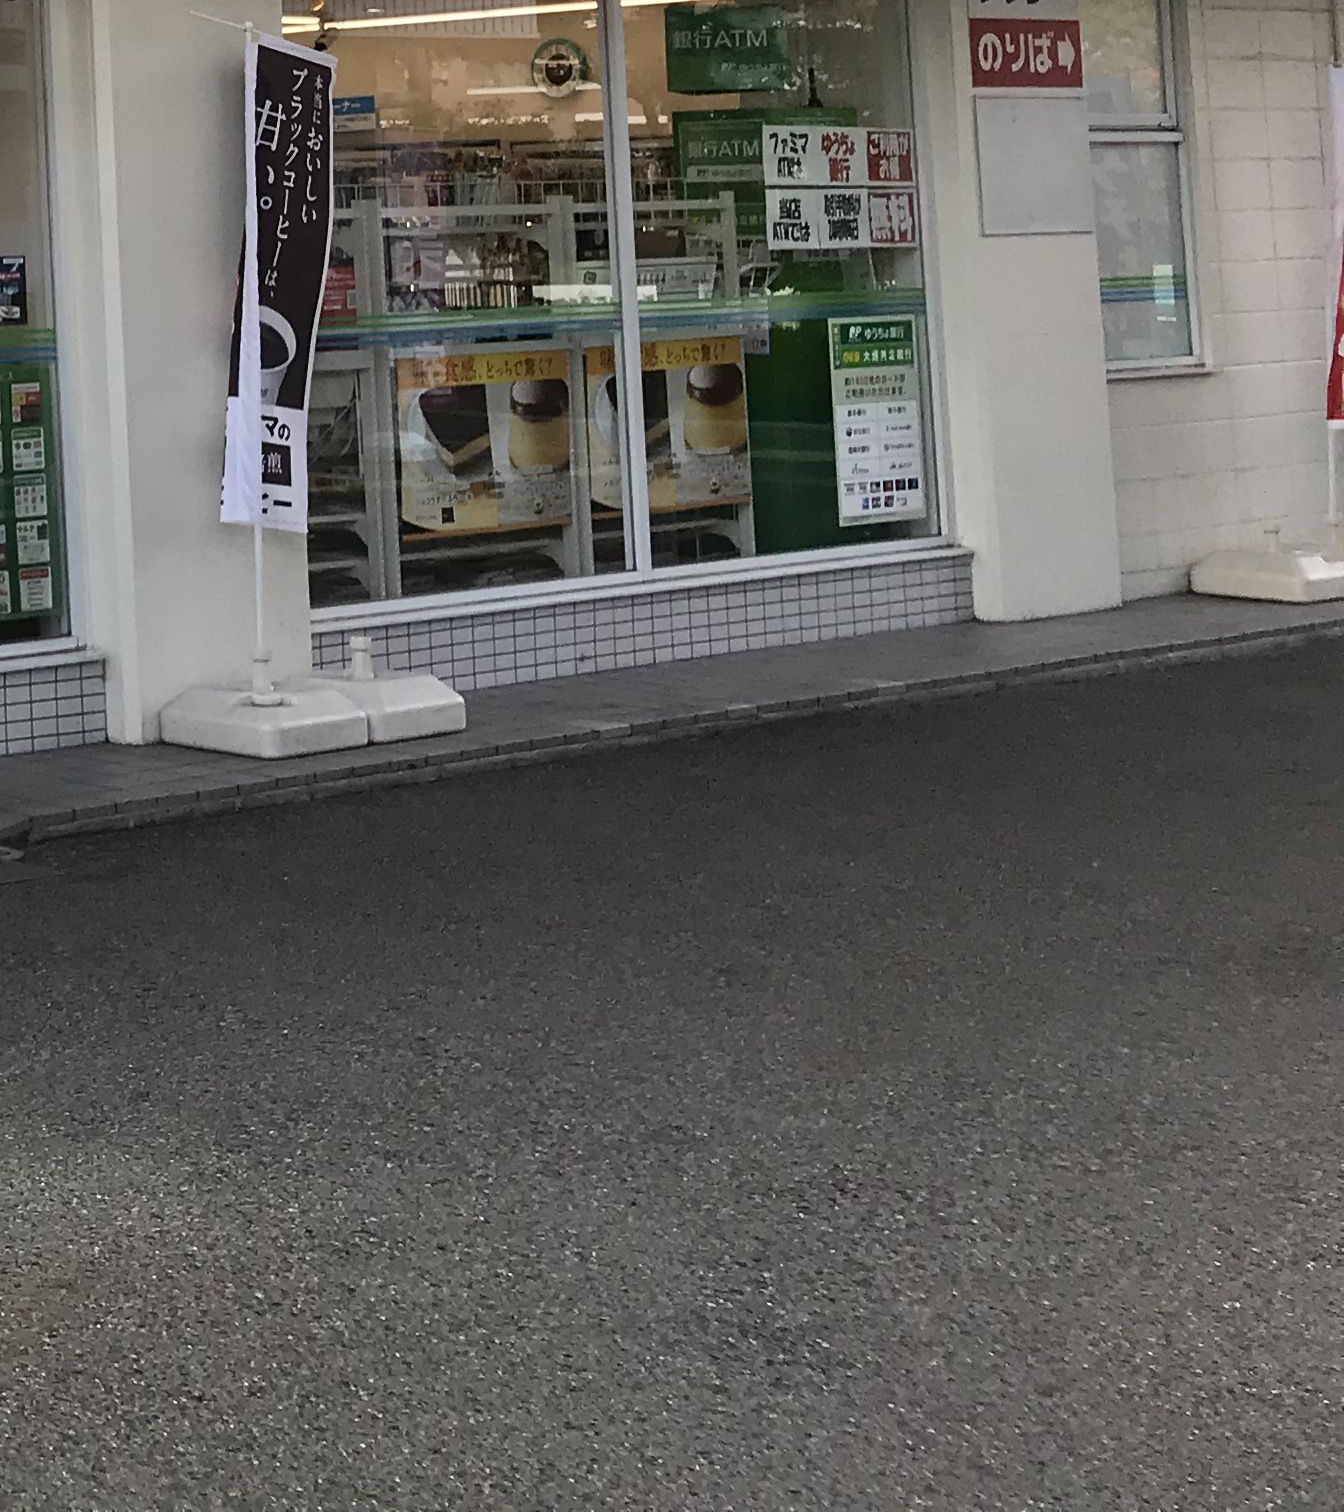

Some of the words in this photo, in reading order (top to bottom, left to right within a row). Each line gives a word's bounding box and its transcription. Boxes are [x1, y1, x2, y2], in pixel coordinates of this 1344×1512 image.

[978, 31, 1055, 74] のりば
[302, 75, 324, 224] 本当においしい
[769, 132, 809, 155] ファミマ
